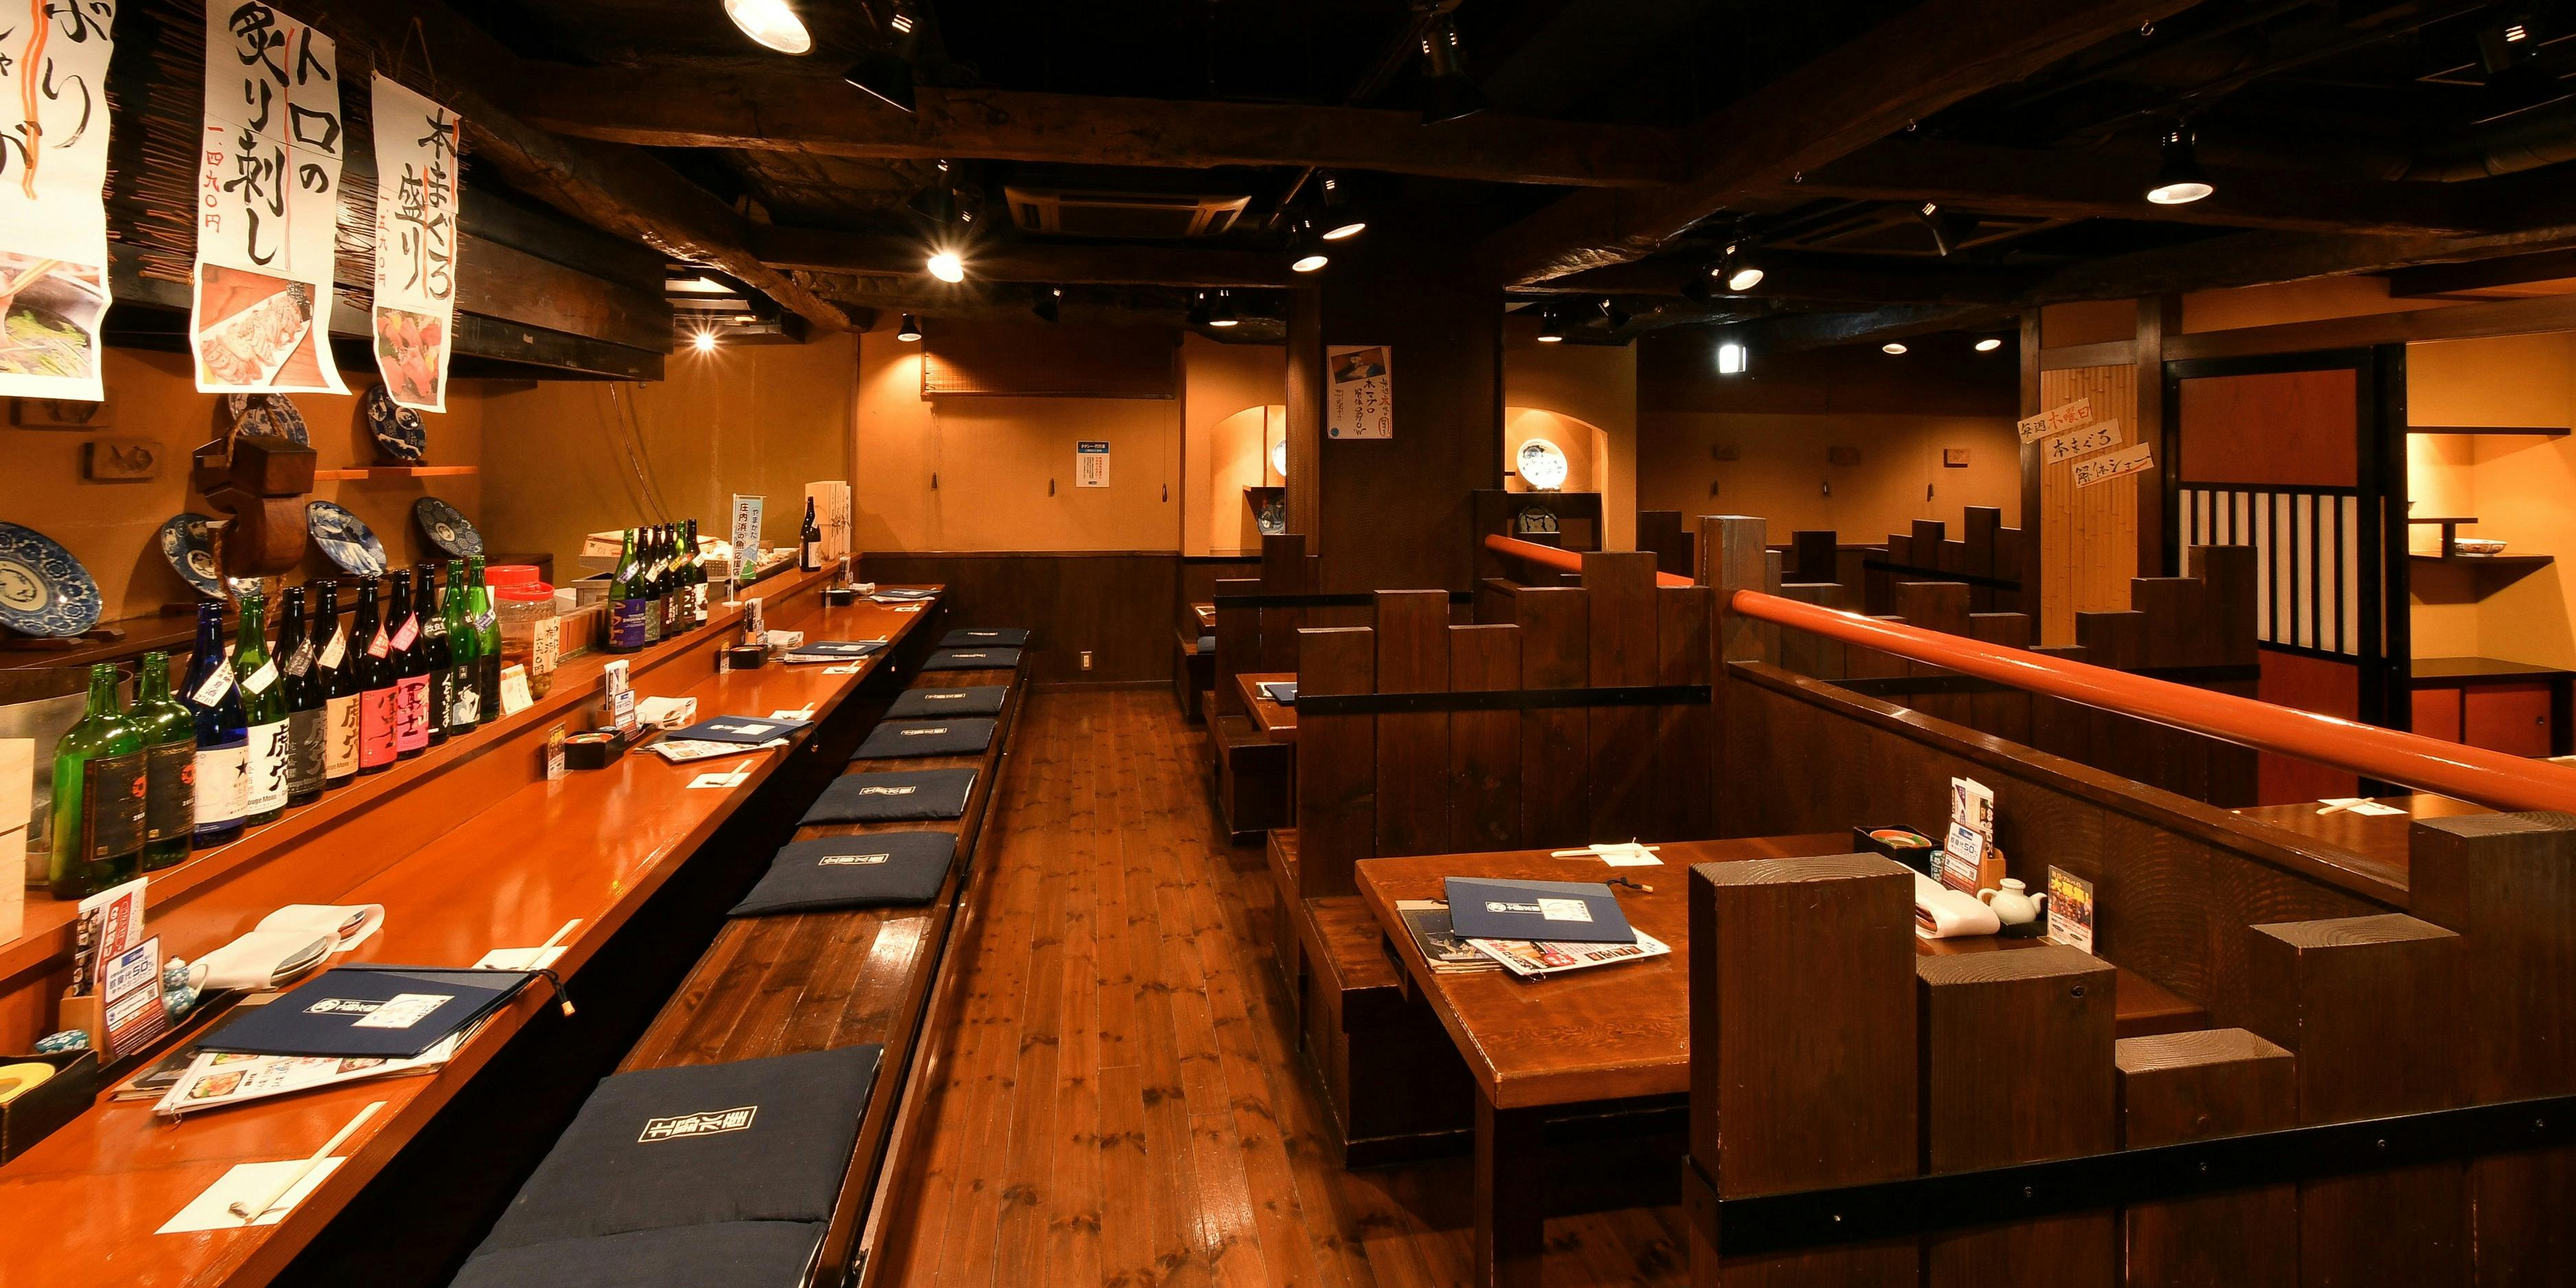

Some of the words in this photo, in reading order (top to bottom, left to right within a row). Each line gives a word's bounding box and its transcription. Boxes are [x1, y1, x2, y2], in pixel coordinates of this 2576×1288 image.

[223, 1, 291, 266] 炙り刺し
[289, 27, 340, 193] トロの
[394, 162, 430, 291] 盛り
[418, 107, 457, 300] 本まぐろ
[2020, 406, 2091, 438] 毎週木曜日
[2053, 429, 2111, 457] 本まぐろ
[2075, 455, 2150, 485] 解体ショー
[733, 502, 749, 576] 庄内浜の魚応援店
[750, 507, 759, 539] やまがた
